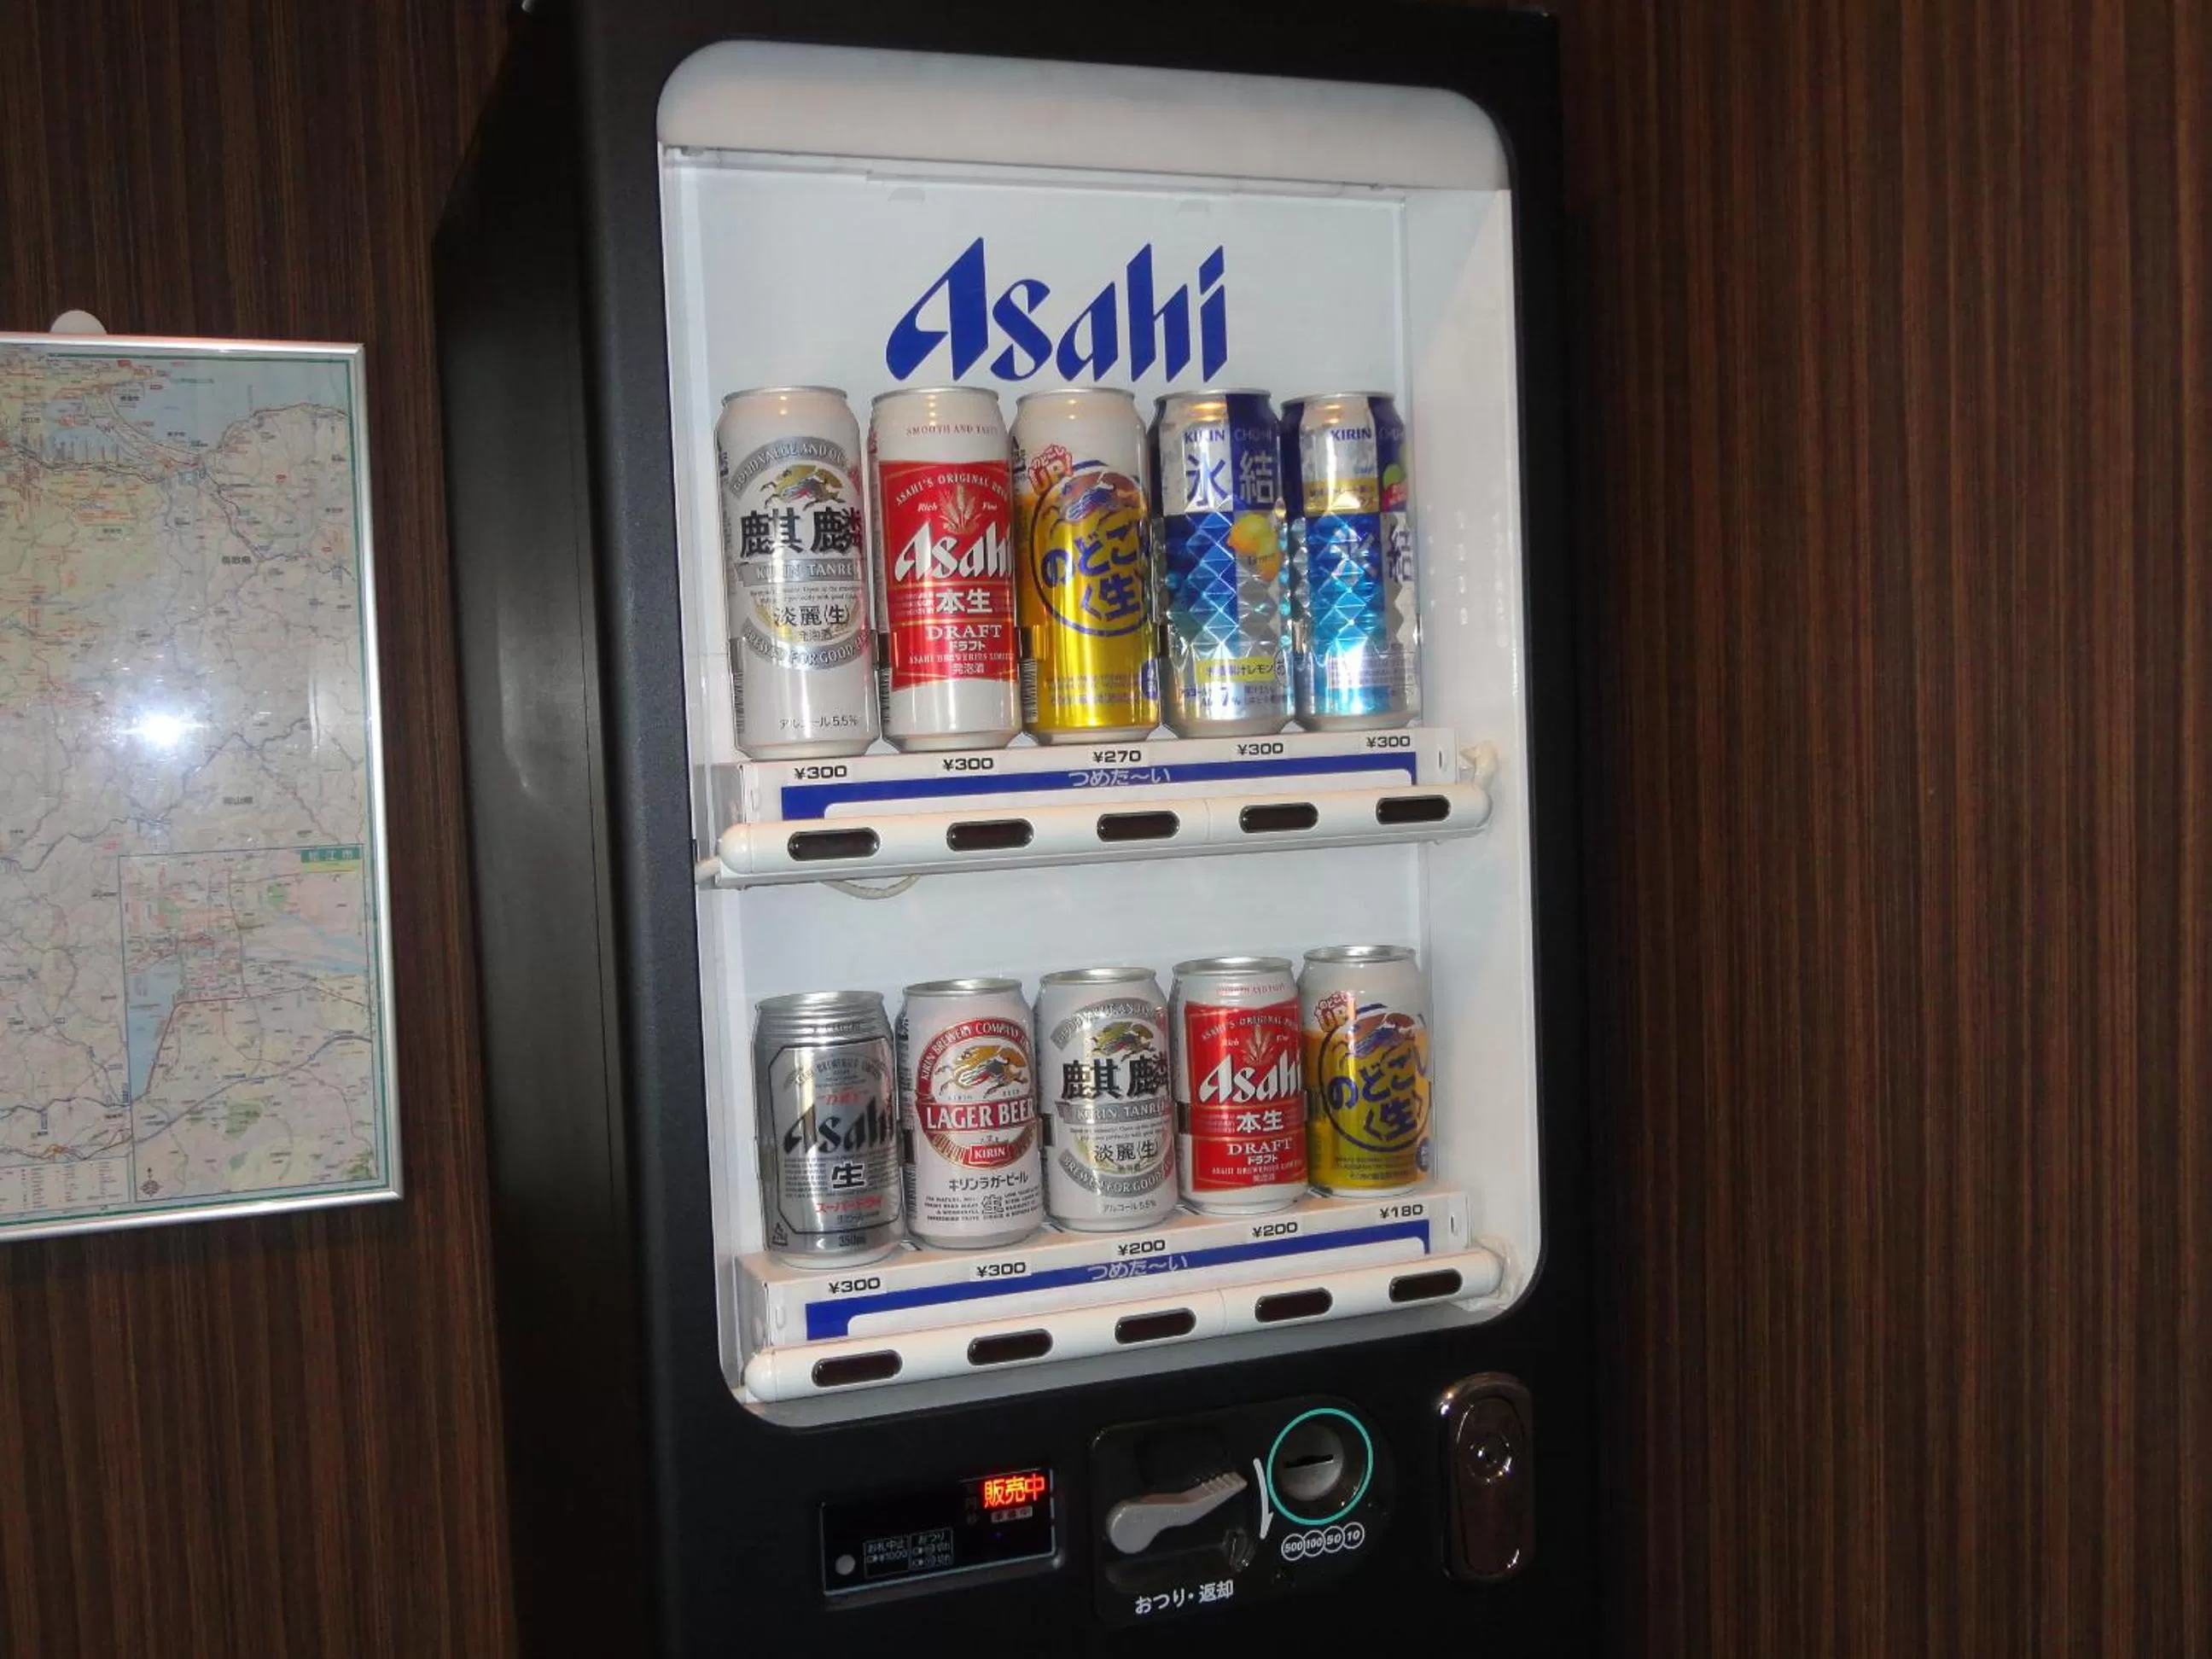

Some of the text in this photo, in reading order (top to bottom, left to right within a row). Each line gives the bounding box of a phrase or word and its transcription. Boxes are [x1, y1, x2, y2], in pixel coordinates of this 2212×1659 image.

[886, 236, 1227, 382] Asahi
[1185, 429, 1225, 444] KIIN
[1330, 428, 1372, 441] KIRIN
[939, 474, 989, 487] ORIGINAL
[1185, 450, 1275, 507] 氷結
[917, 502, 938, 512] Rich
[894, 521, 1014, 582] Asahi
[935, 588, 993, 614] 本生
[926, 624, 1003, 640] DRAFT
[949, 641, 987, 653] ドラフト
[1237, 742, 1284, 756] ¥300
[1366, 735, 1411, 748] ¥300
[943, 757, 994, 771] ¥300
[1093, 749, 1142, 764] ¥270
[795, 765, 847, 780] ¥300
[921, 1055, 936, 1081] KIRIN
[1198, 1048, 1302, 1104] Asahi
[926, 1097, 1036, 1130] LAGER BEER
[1236, 1109, 1284, 1133] 本生
[783, 1094, 894, 1153] Asahi
[974, 1146, 1006, 1159] KIRIN
[1226, 1138, 1293, 1155] DRAFT
[1247, 1153, 1278, 1166] ドラフト
[831, 1161, 866, 1190] 生
[949, 1171, 1029, 1191] キリンラガービール
[1379, 1203, 1423, 1220] ¥180
[1252, 1221, 1298, 1238] ¥200
[1117, 1239, 1166, 1256] ¥200
[976, 1261, 1026, 1278] ¥300
[828, 1277, 881, 1295] ¥300
[984, 1473, 1045, 1509] 販売中
[1284, 1529, 1361, 1553] 500 100 50 10
[1135, 1579, 1234, 1615] おつり・返却
